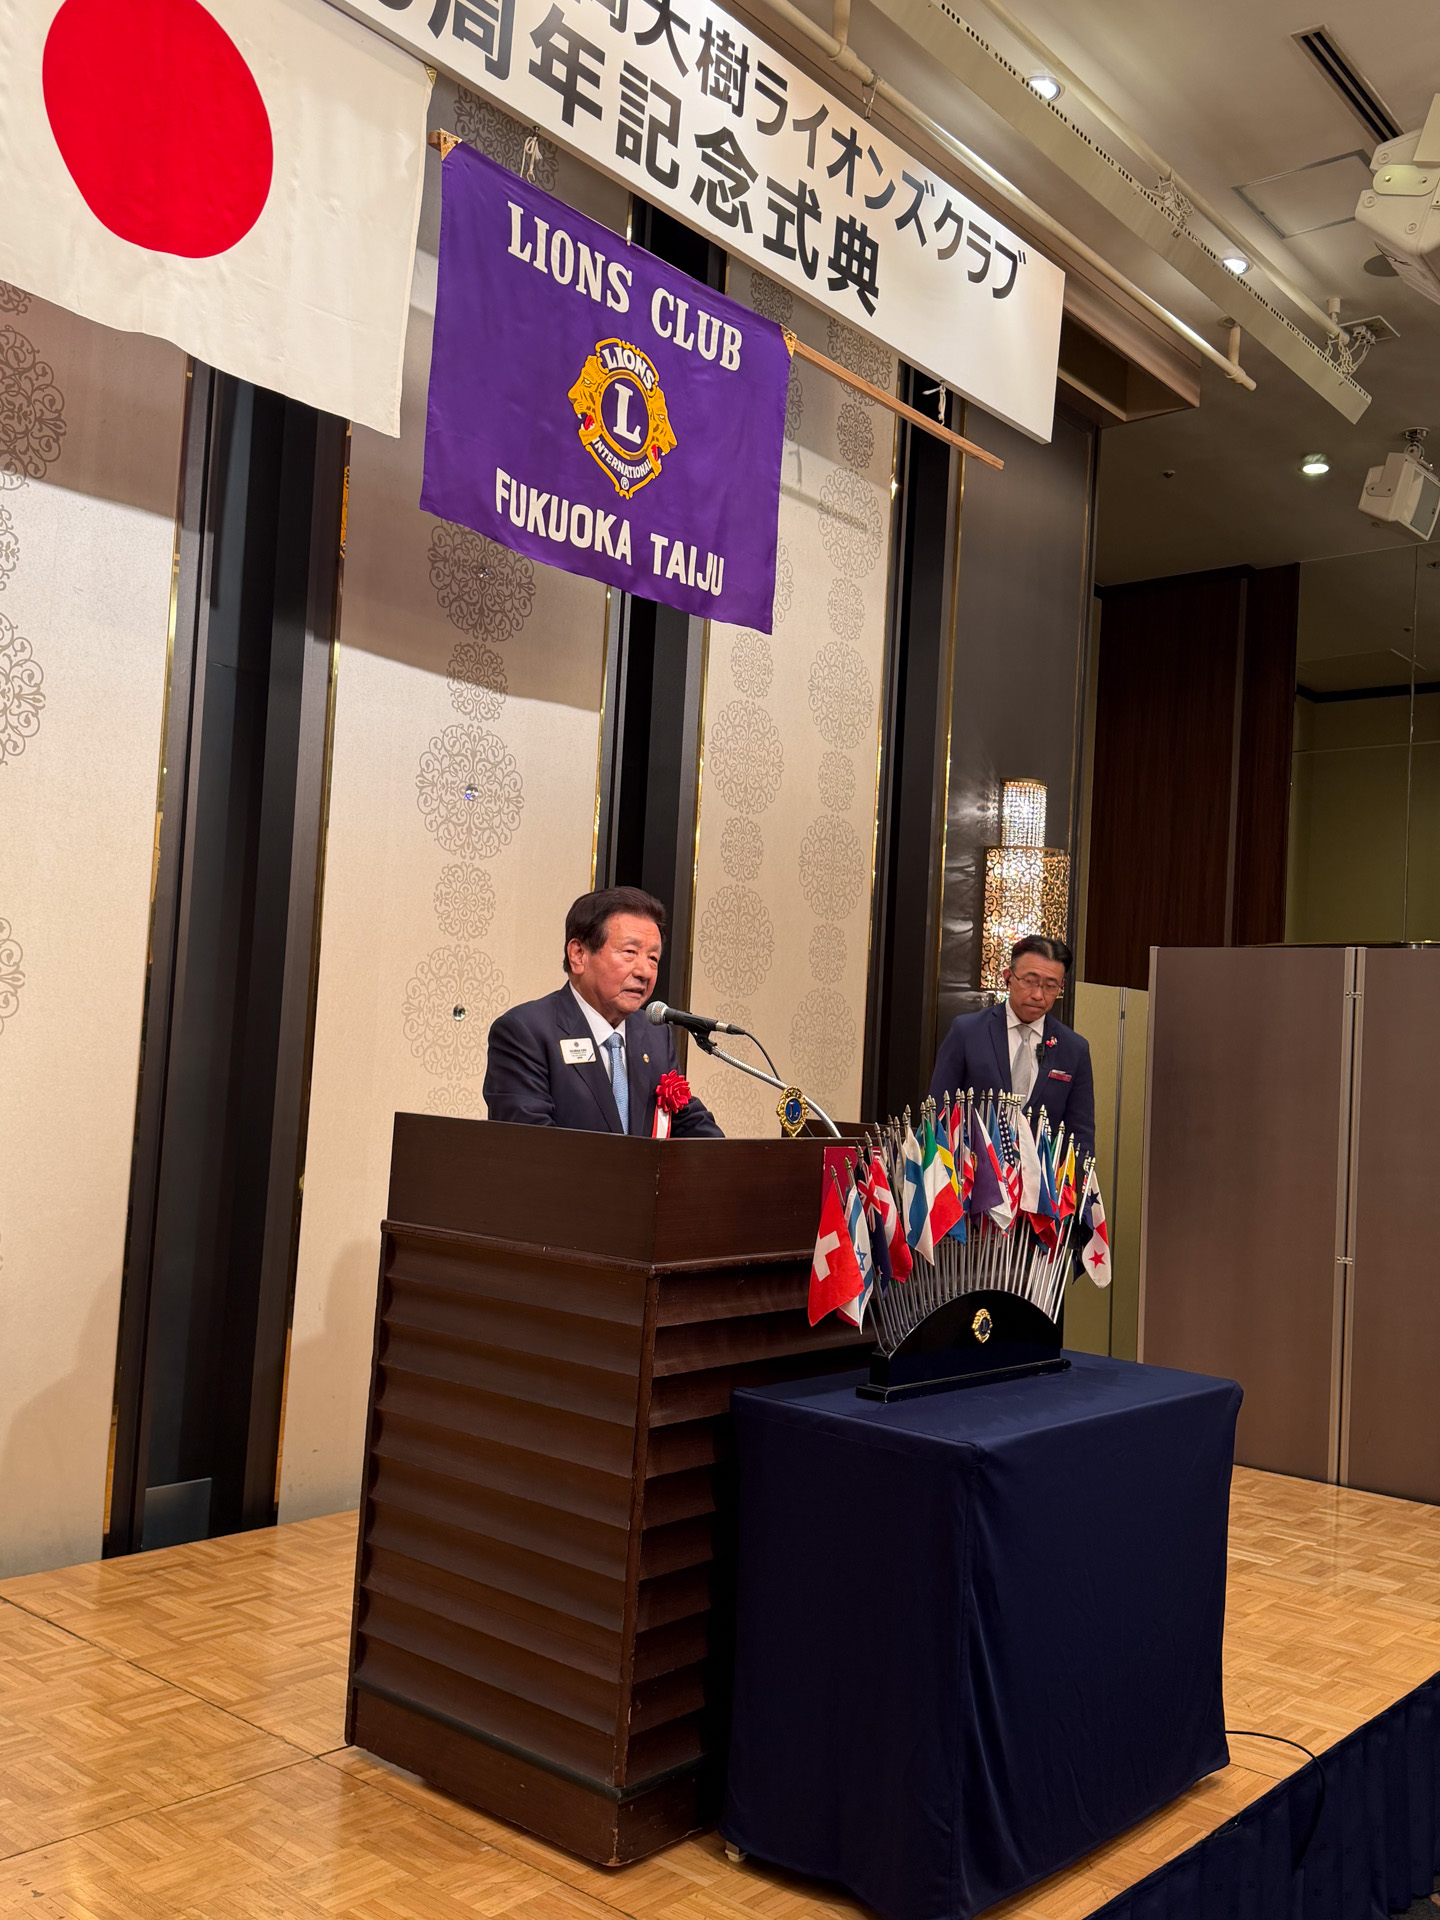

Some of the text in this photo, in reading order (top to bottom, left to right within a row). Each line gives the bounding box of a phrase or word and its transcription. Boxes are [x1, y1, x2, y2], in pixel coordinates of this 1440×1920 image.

[378, 0, 880, 318] 周年記念式典
[507, 200, 743, 372] LIONS CLUB
[601, 346, 656, 390] LIONS
[612, 382, 642, 445] L
[592, 436, 653, 479] INTERNATIONAL
[495, 467, 725, 597] FUKUOKA TAIJU
